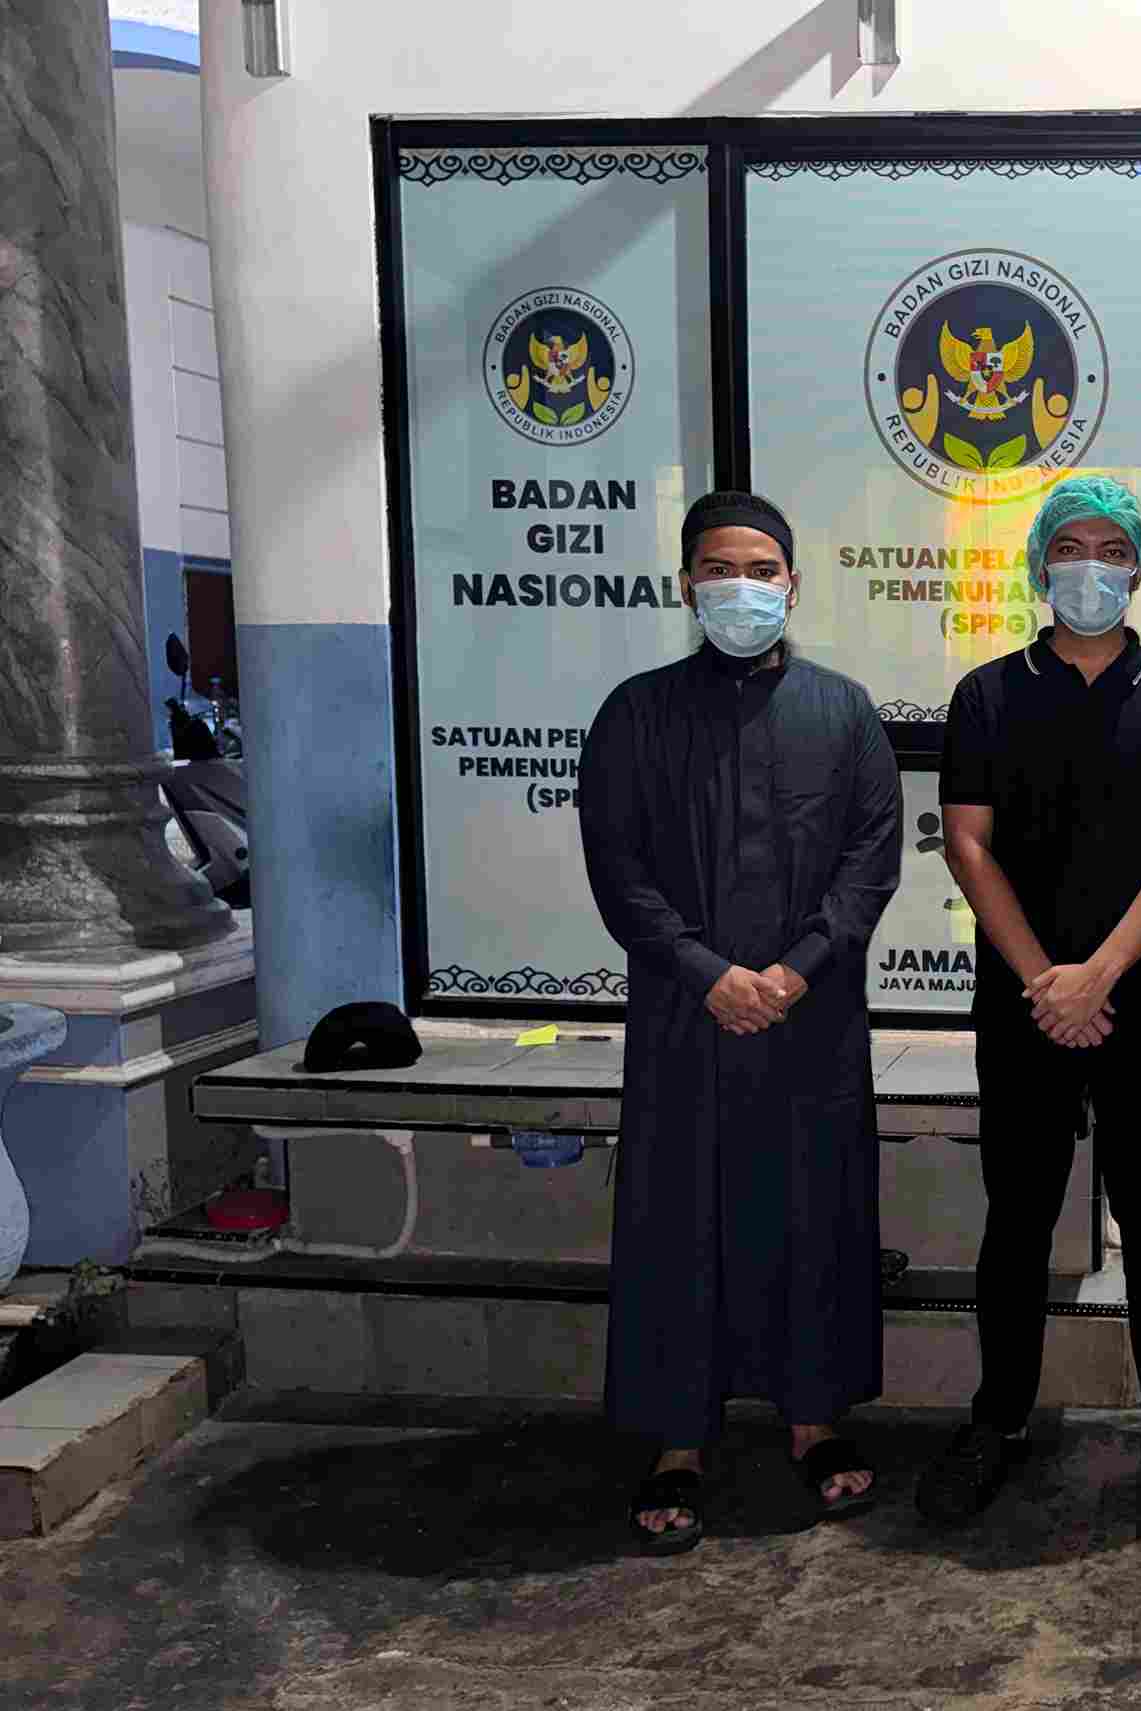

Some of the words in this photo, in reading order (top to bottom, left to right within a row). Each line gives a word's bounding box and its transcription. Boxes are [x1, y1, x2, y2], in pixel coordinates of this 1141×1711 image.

[885, 274, 944, 339] BADAN
[948, 260, 989, 281] GIZI
[997, 261, 1088, 340] NASIONAL
[495, 303, 531, 343] BADAN
[534, 293, 560, 306] GIZI
[563, 295, 622, 343] NASIONAL
[496, 391, 555, 440] REPUBLIK
[559, 391, 623, 440] INDONESIA
[886, 414, 976, 491] REPUBLIK
[492, 479, 636, 510] BADAN
[527, 523, 604, 554] GIZI
[839, 547, 957, 569] SATUAN
[452, 573, 682, 608] NASIONAL
[941, 608, 1038, 641] (SPPG)
[431, 726, 541, 748] SATUAN
[459, 756, 577, 778] PEMENU
